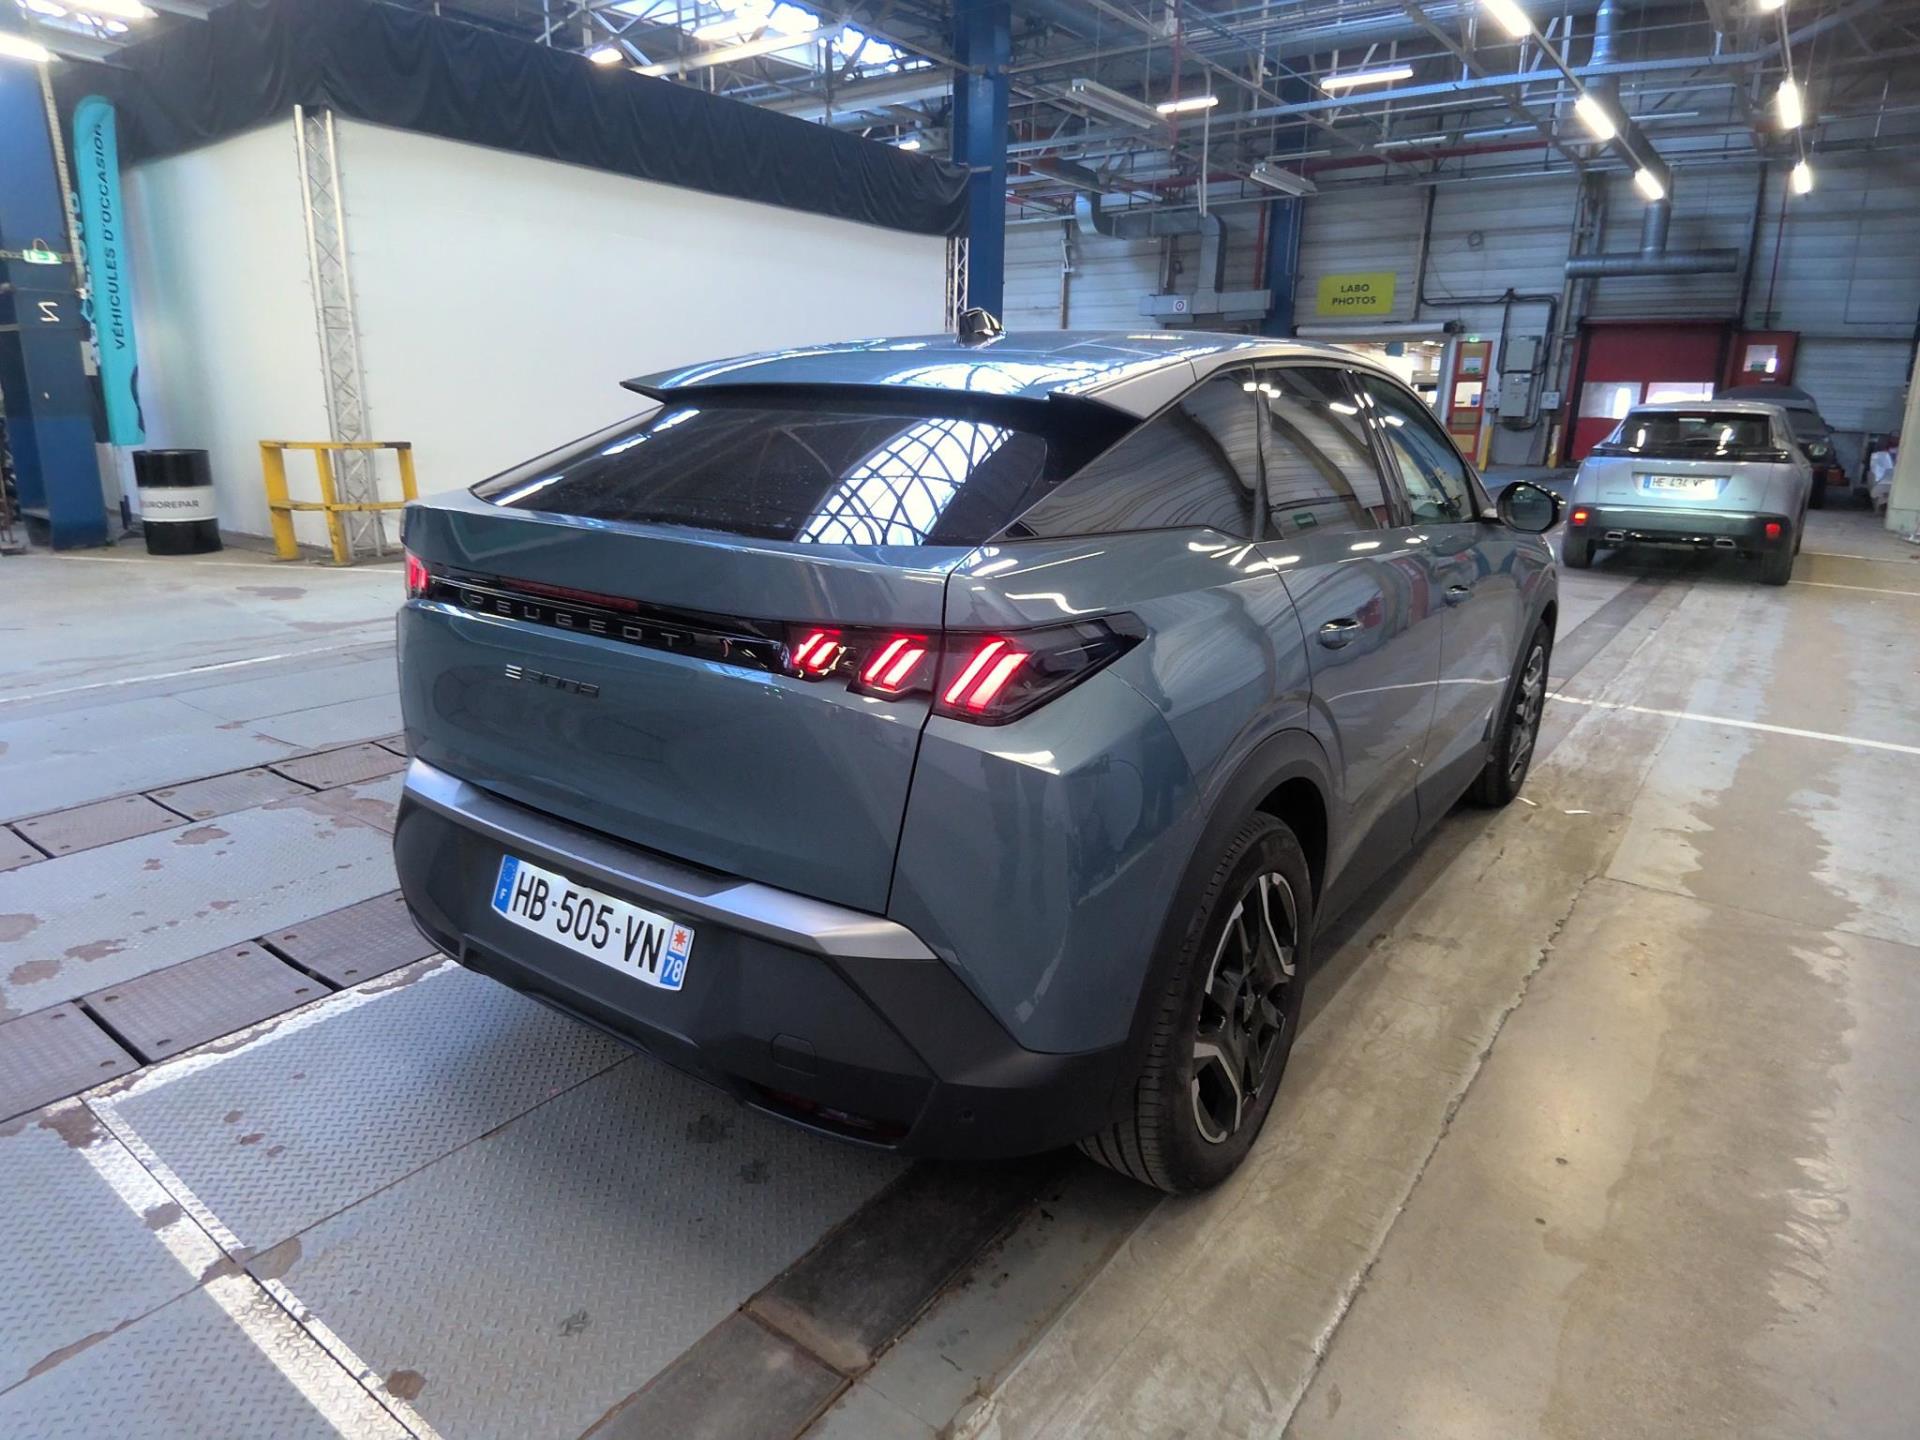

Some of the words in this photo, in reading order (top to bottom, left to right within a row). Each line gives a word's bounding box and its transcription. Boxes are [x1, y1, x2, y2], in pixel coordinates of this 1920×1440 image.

[106, 246, 125, 350] VÉHICULES
[1340, 283, 1370, 293] LABO
[1331, 296, 1377, 305] PHOTOS
[469, 593, 681, 648] PEUGEOT
[499, 888, 507, 900] F
[663, 955, 684, 983] 78
